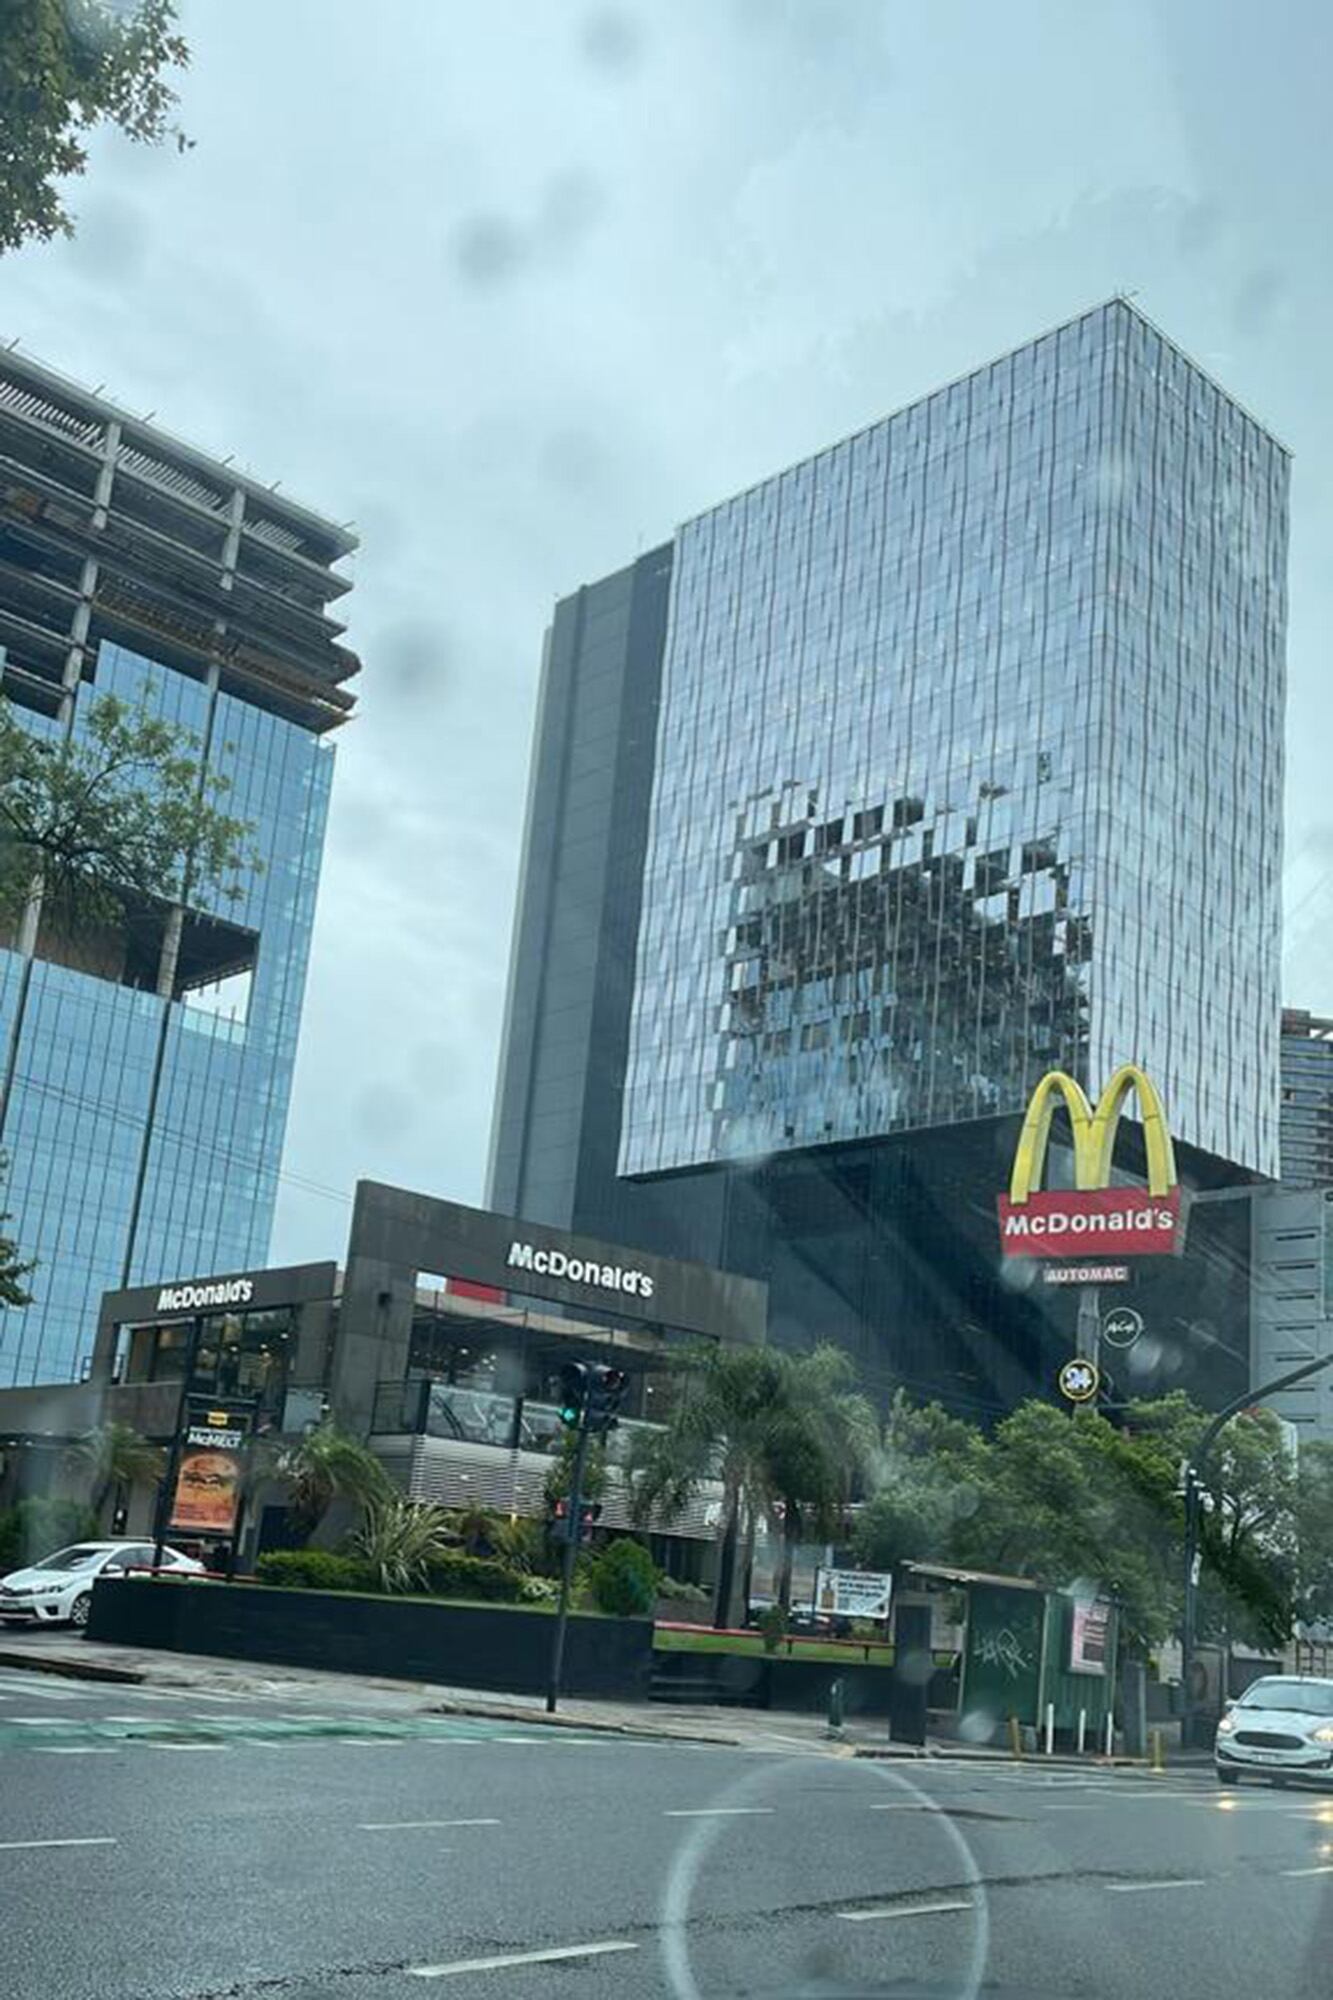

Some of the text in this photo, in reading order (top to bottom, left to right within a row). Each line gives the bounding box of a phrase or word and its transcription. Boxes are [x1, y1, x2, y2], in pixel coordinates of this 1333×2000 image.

[1005, 1207, 1174, 1236] McDonald's
[506, 1241, 654, 1298] McDonald's
[1046, 1266, 1126, 1282] AUTOMAC
[157, 1279, 254, 1312] McDonald's
